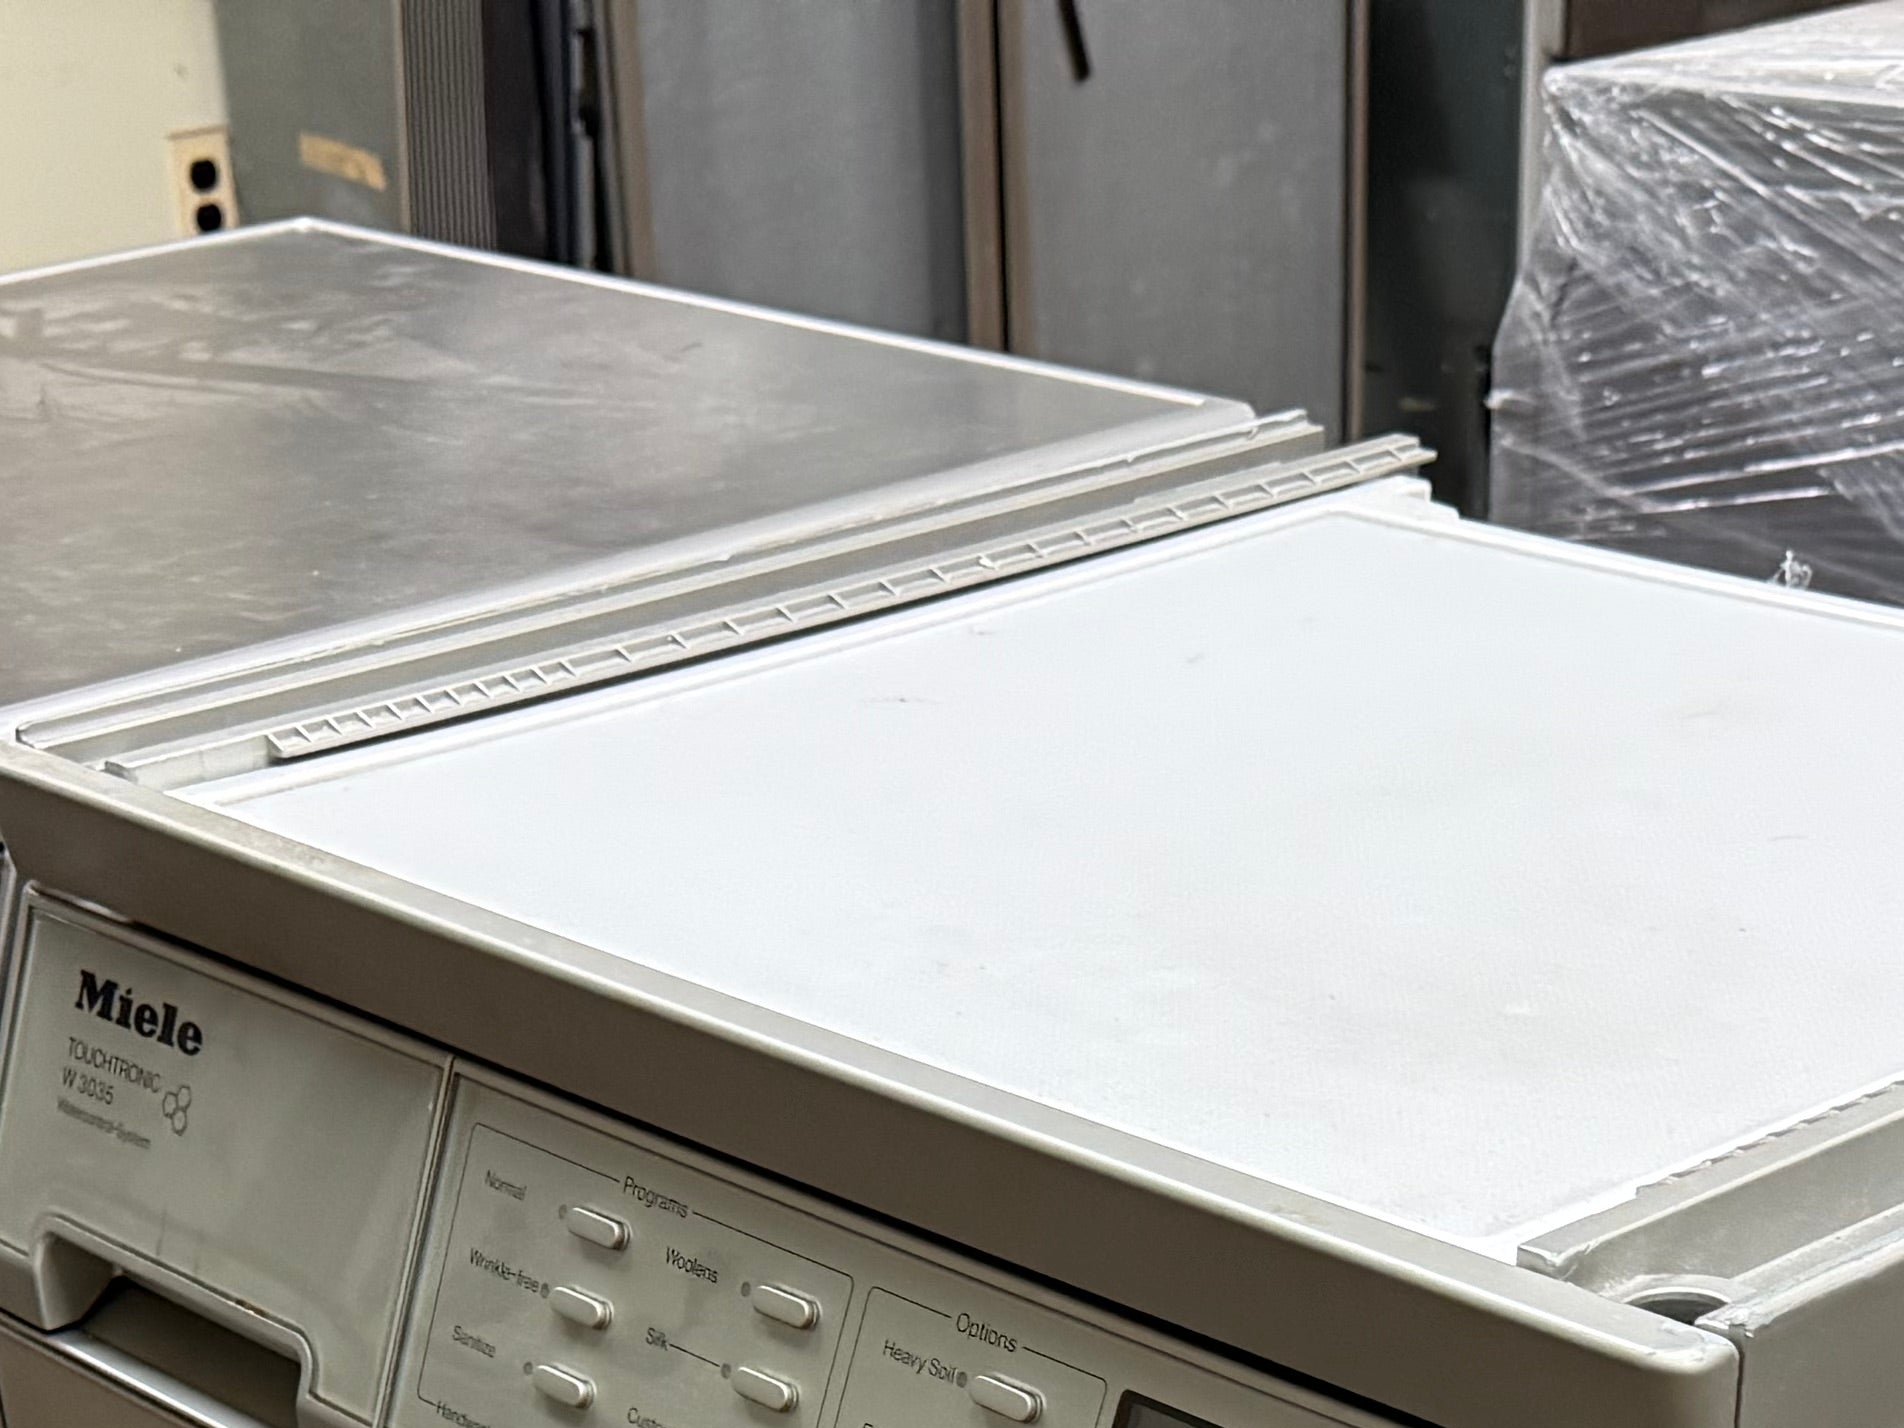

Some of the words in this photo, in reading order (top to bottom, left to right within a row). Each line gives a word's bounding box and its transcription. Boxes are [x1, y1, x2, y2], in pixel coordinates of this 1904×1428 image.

[75, 970, 203, 1057] Miele
[62, 1066, 76, 1088] W
[68, 1036, 161, 1093] TOUCHTRONIC
[484, 1169, 527, 1201] Normal
[622, 1177, 688, 1218] Programs
[666, 1246, 719, 1283] Woolens
[452, 1325, 496, 1358] Sanitize
[645, 1327, 669, 1351] Silk
[956, 1313, 1018, 1352] Options
[883, 1339, 927, 1374] Heavy
[928, 1358, 957, 1383] Soil
